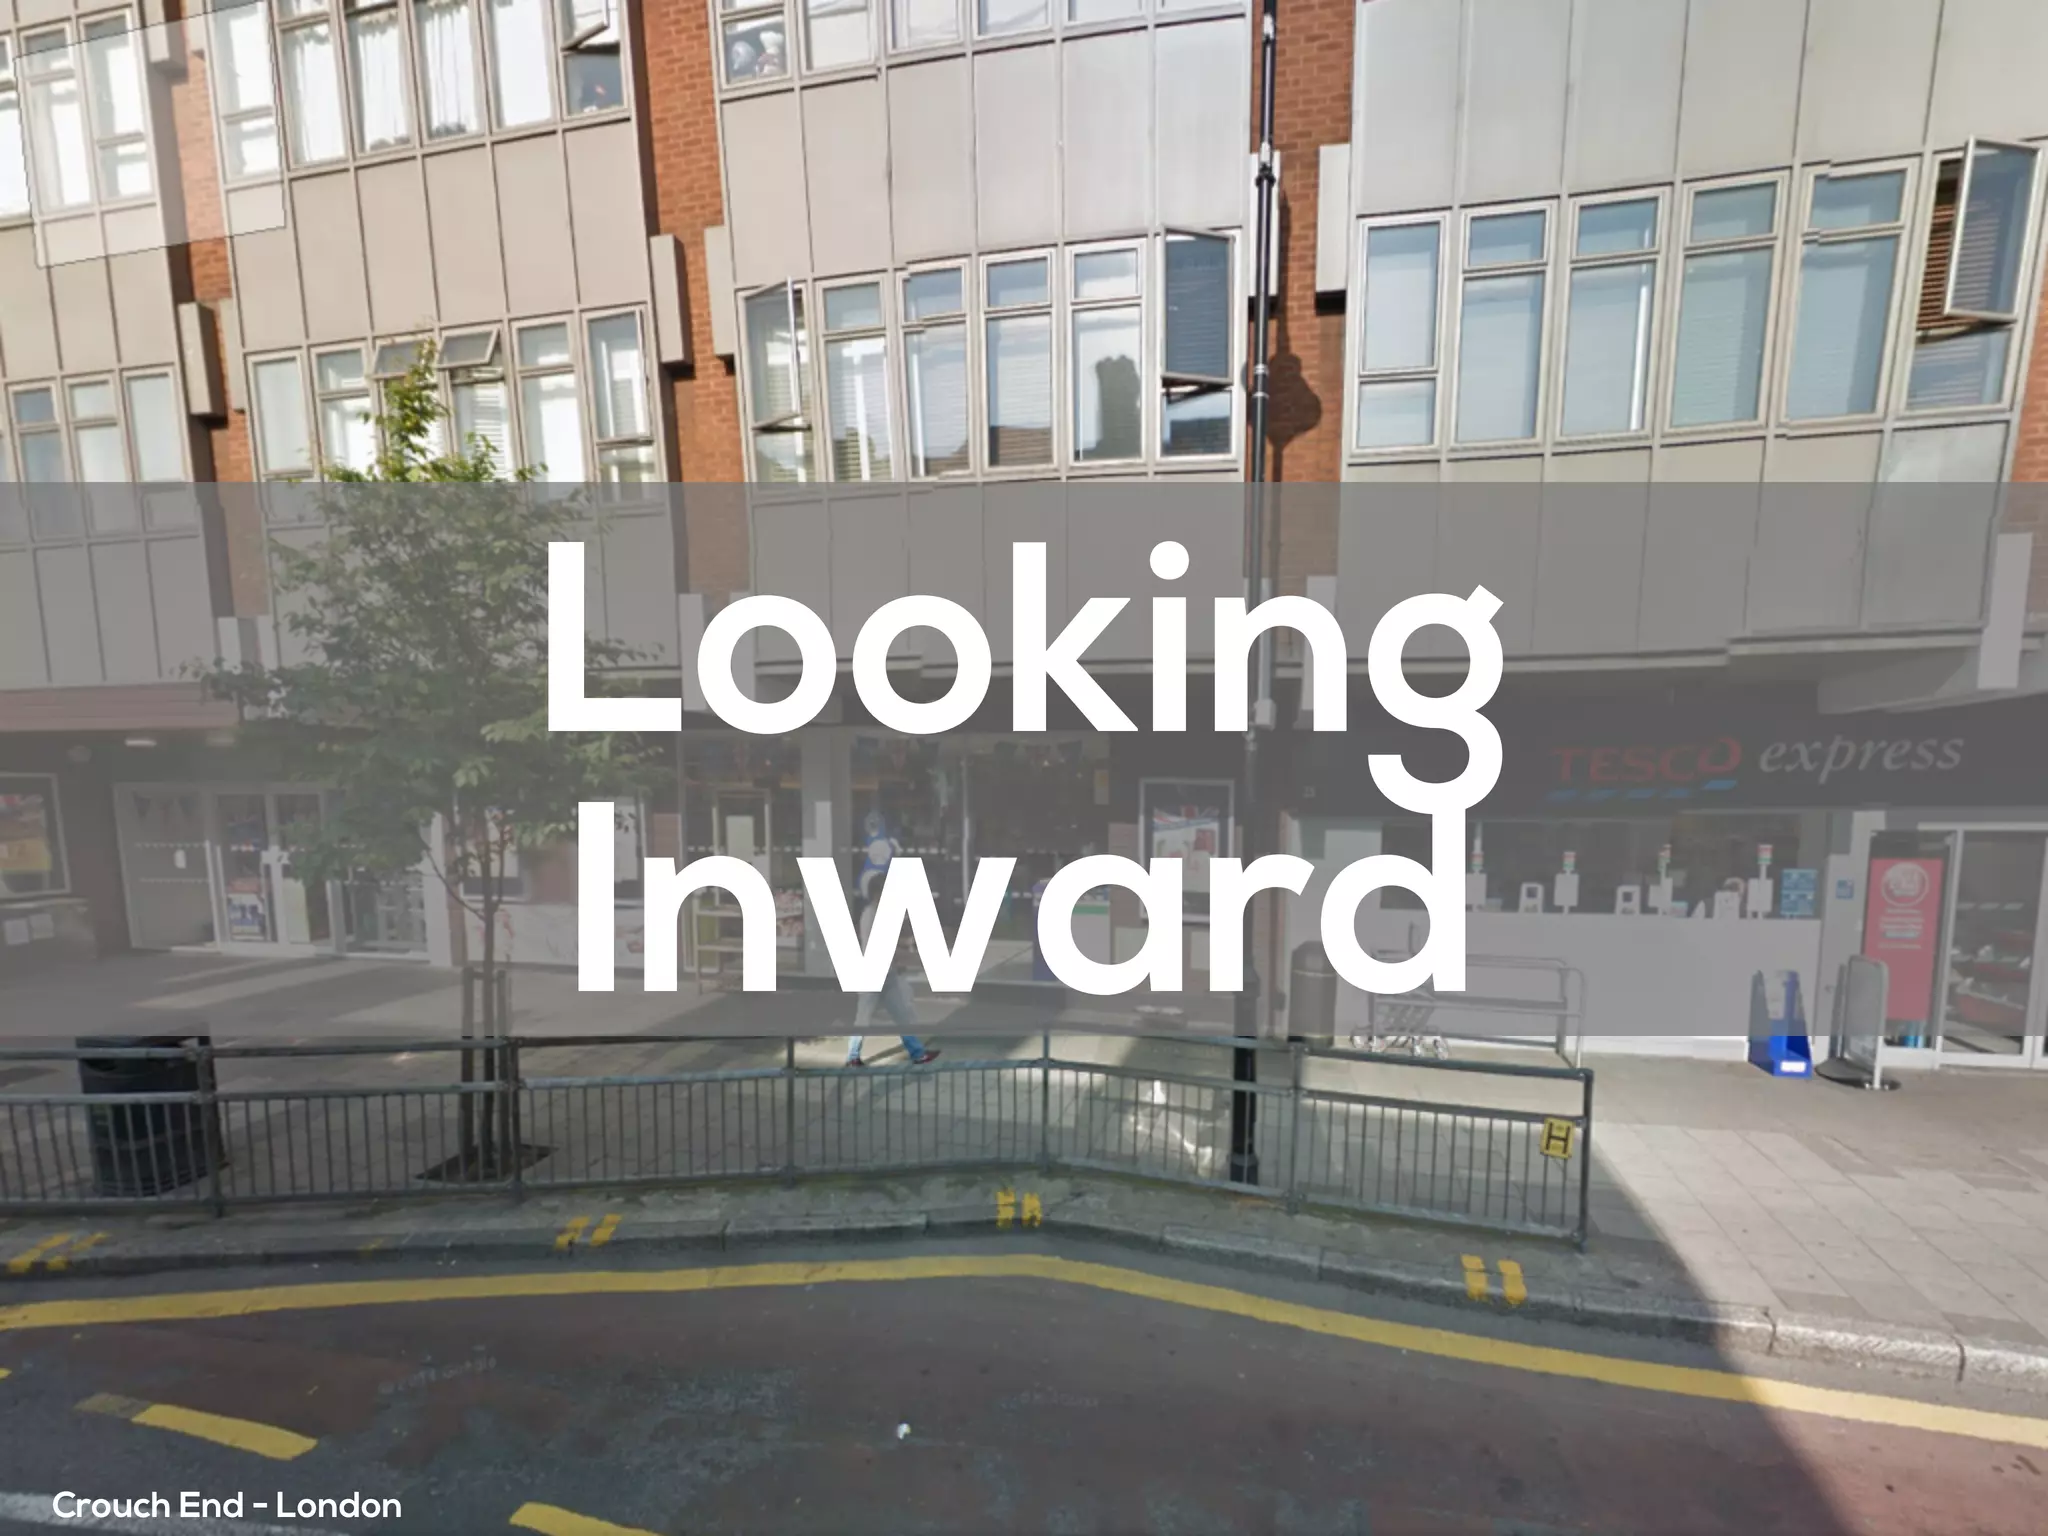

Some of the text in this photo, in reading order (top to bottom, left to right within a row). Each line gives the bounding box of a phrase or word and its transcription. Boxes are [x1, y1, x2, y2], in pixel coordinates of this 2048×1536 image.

[1551, 734, 1964, 783] TESCO express
[1545, 1121, 1571, 1155] H
